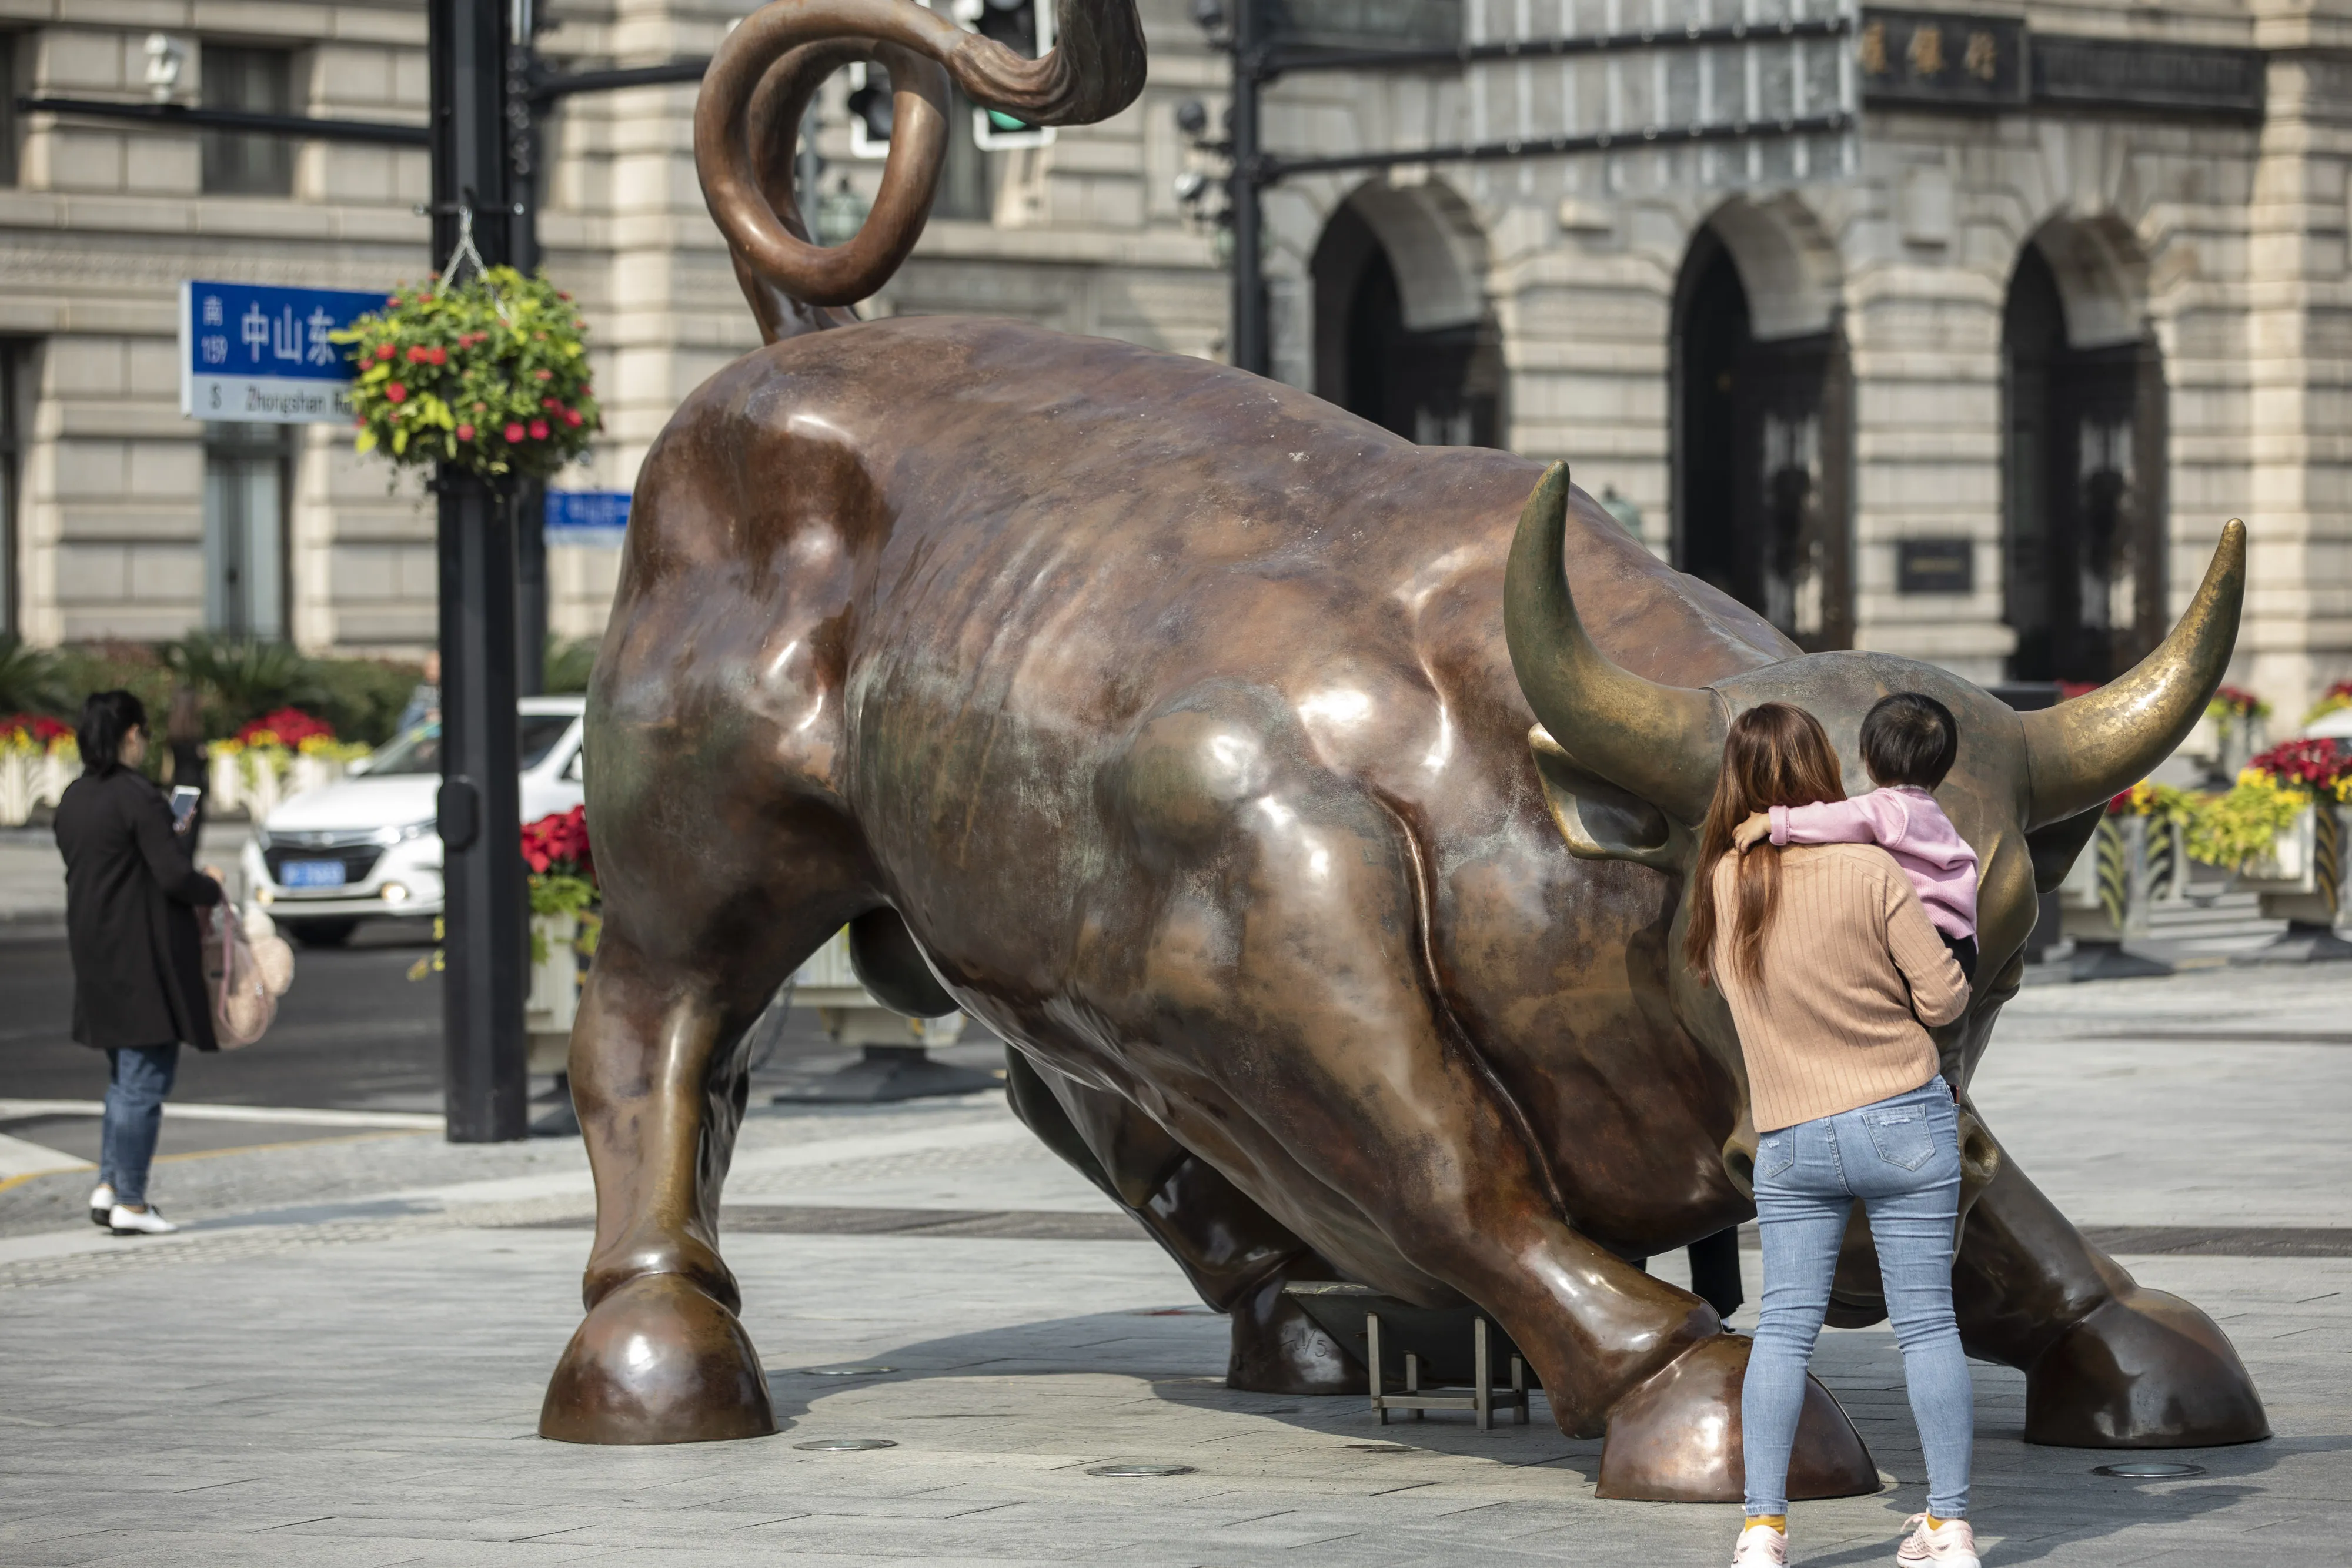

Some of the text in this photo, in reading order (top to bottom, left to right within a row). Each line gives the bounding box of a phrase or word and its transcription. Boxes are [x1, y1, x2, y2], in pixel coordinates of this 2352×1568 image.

[203, 294, 223, 326] 南
[242, 300, 335, 366] 中山东
[209, 383, 222, 409] S
[246, 385, 326, 416] Zhongshan
